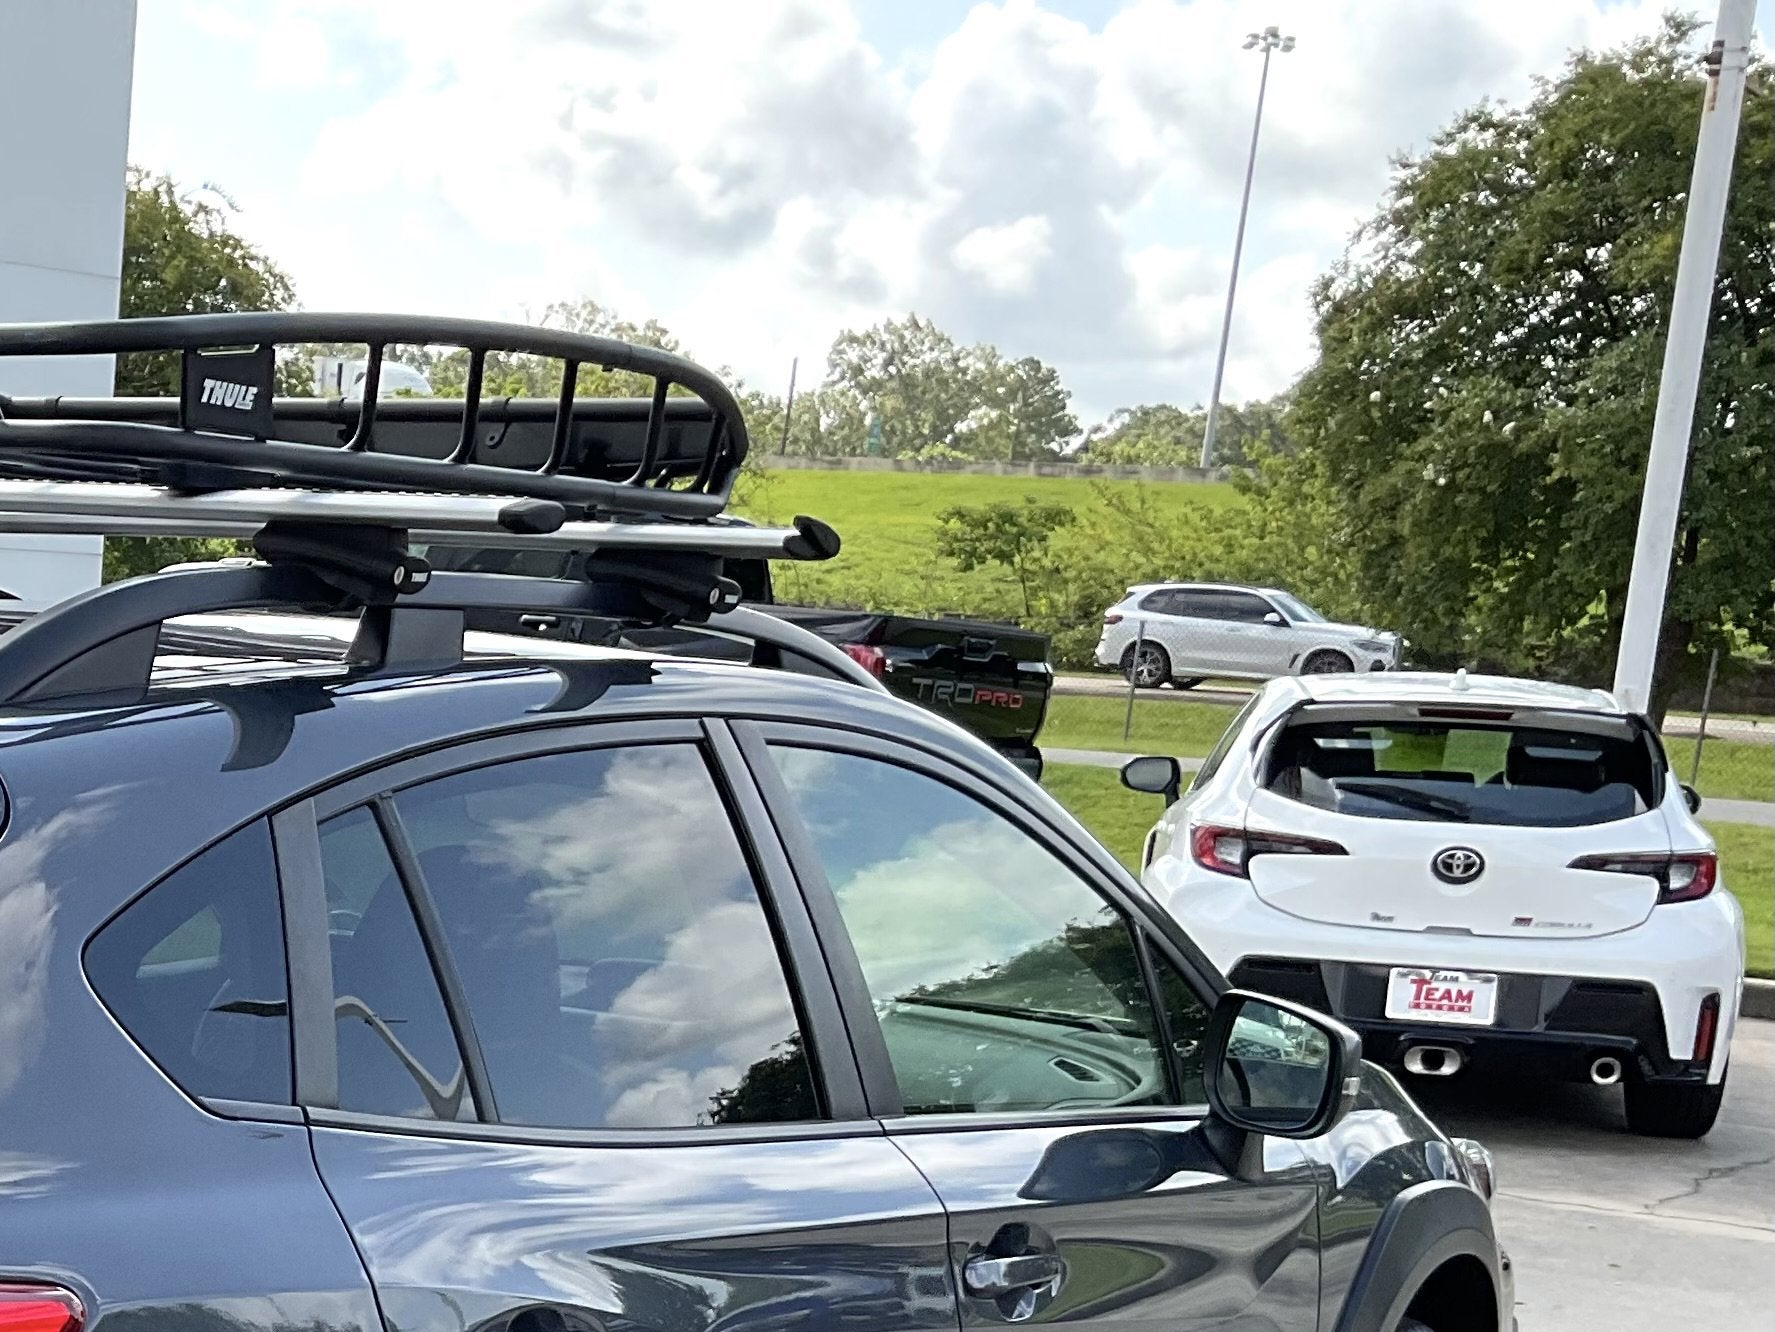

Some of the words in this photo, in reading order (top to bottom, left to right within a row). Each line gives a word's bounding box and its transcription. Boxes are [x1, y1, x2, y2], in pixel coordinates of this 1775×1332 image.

[201, 378, 258, 410] THULE
[974, 690, 1023, 709] PRO
[1409, 978, 1475, 1005] TEAM
